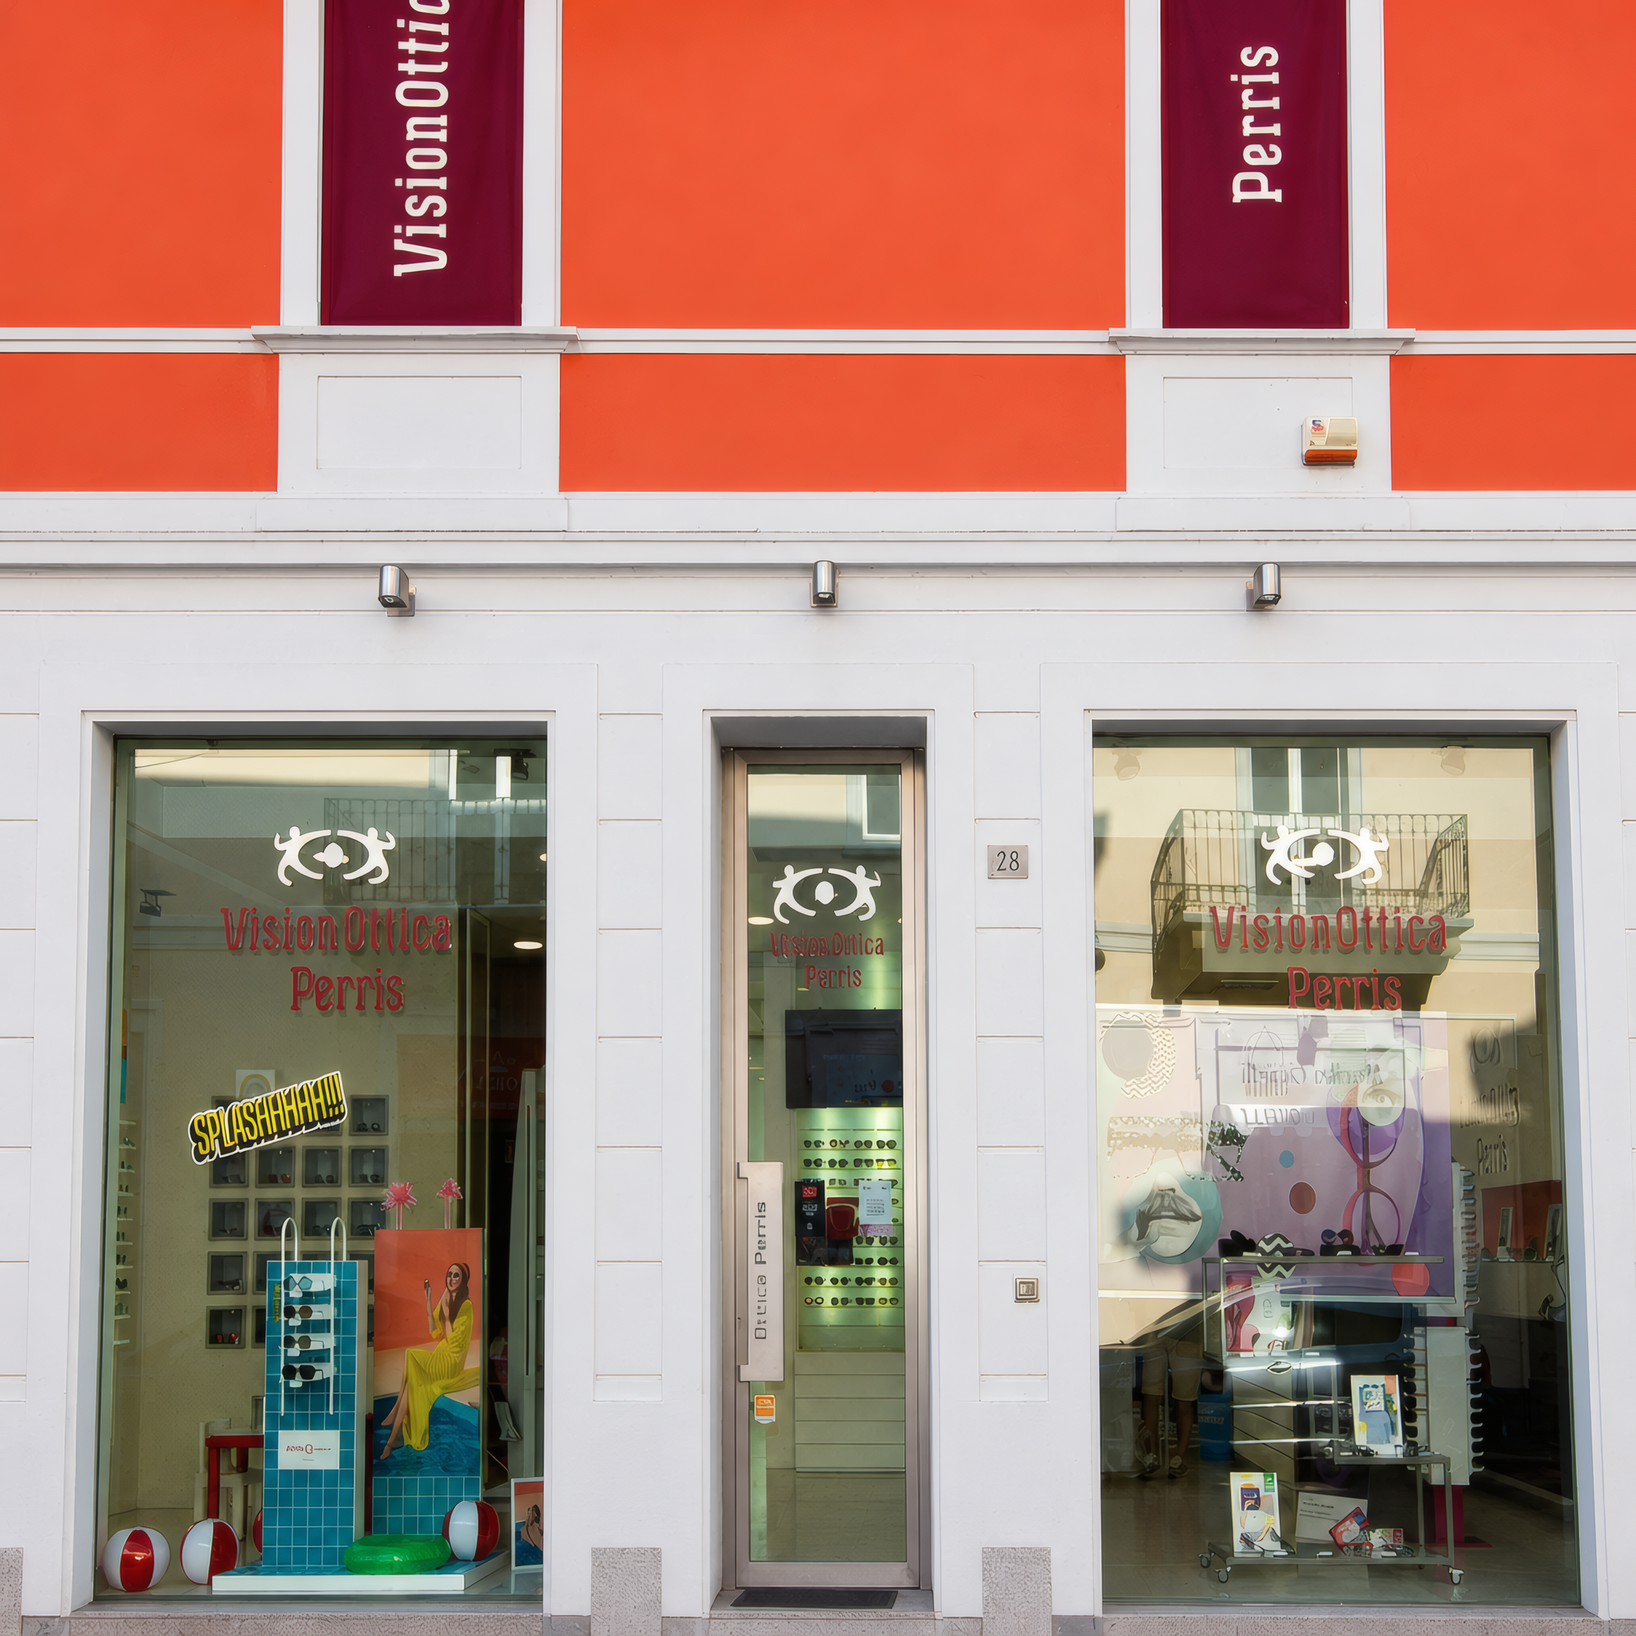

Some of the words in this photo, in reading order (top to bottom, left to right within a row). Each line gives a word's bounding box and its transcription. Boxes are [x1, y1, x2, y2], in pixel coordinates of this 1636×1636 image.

[1230, 45, 1283, 203] Perris
[996, 850, 1020, 872] 28
[1208, 905, 1448, 950] VisionOttica
[290, 966, 404, 1011] Perris
[1287, 966, 1402, 1011] Perris
